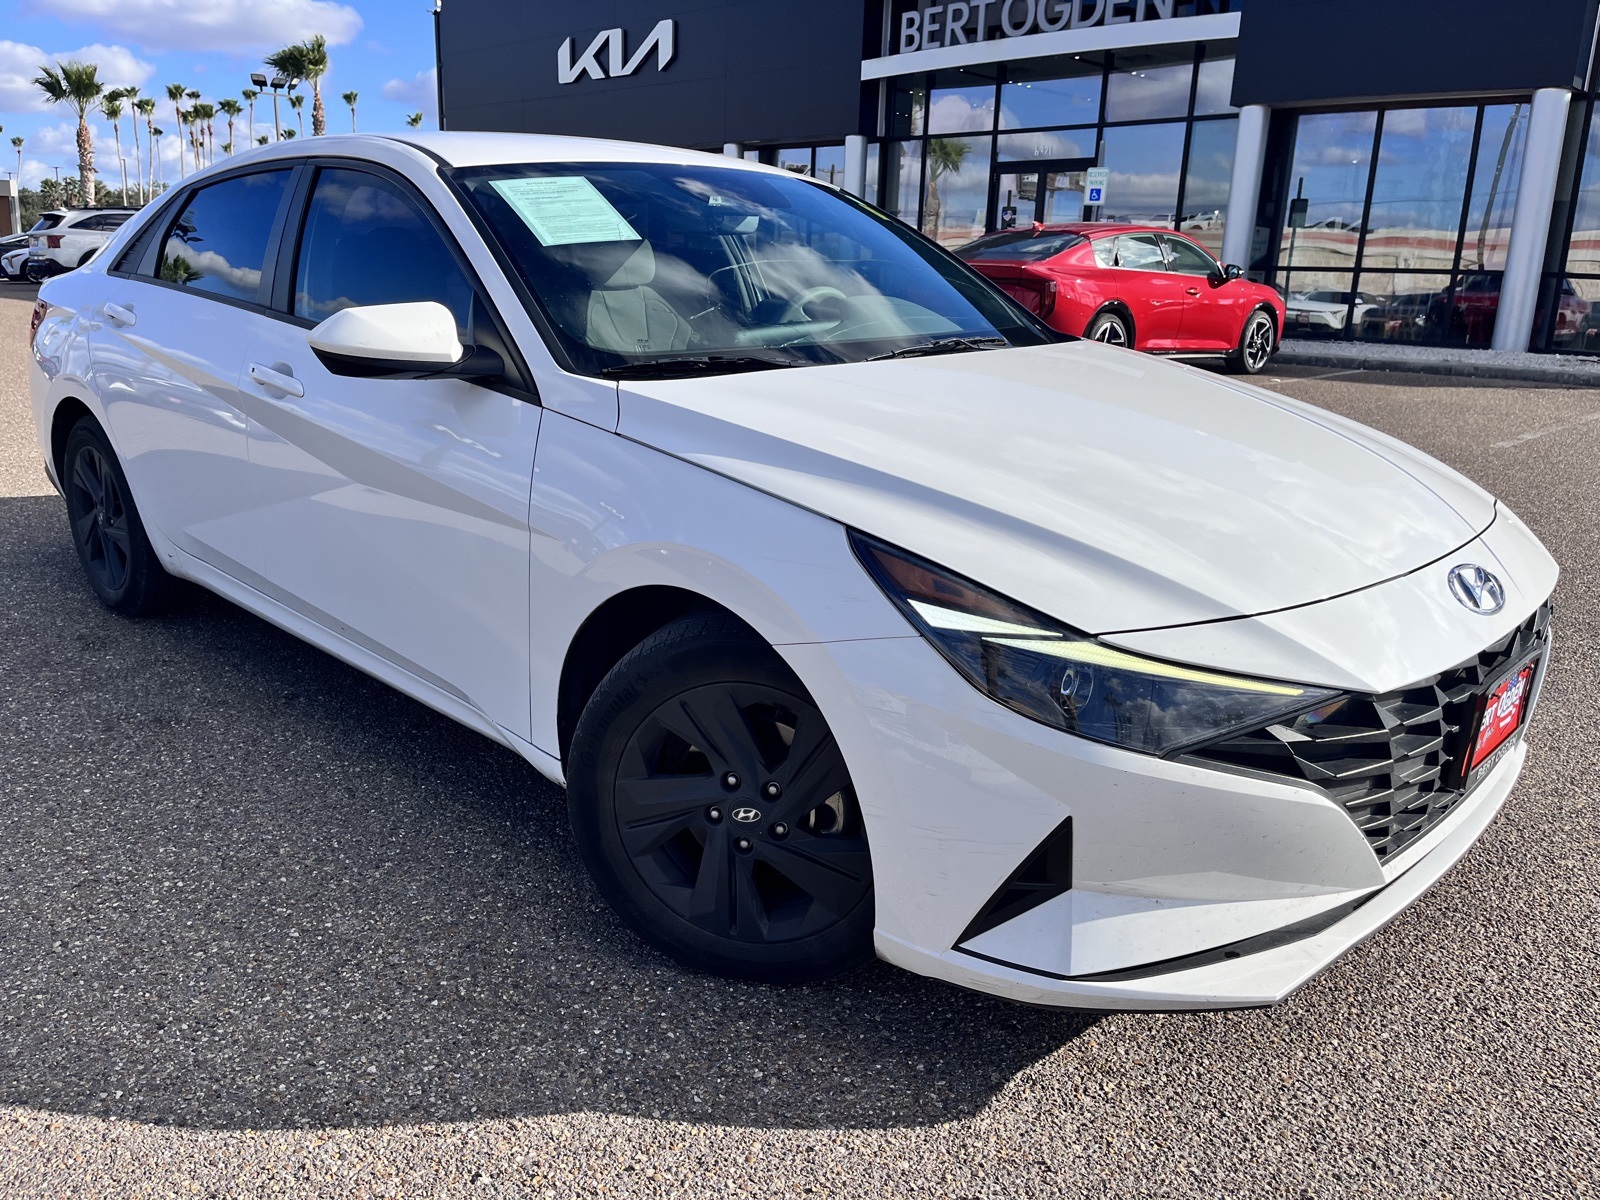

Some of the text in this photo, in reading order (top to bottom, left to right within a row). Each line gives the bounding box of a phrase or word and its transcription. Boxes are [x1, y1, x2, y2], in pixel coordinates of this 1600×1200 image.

[557, 18, 674, 84] KIA
[900, 0, 996, 54] BERT
[1480, 701, 1498, 732] ERT
